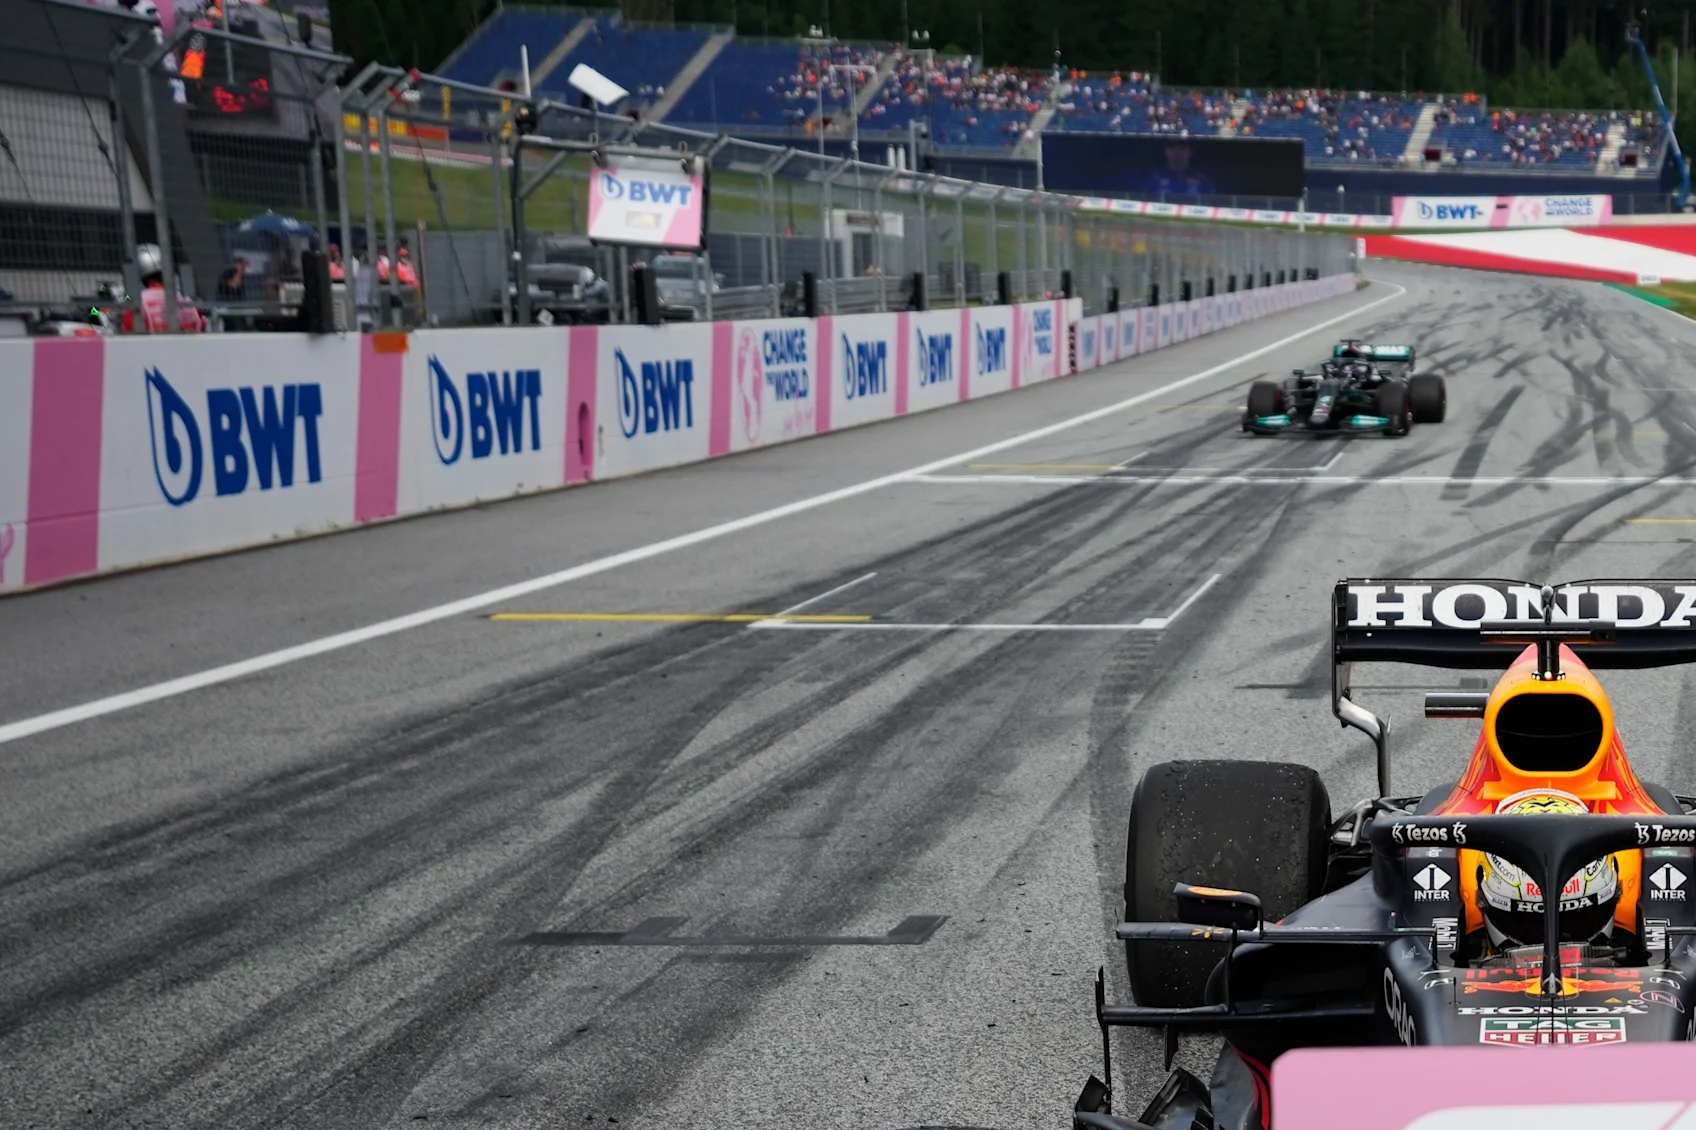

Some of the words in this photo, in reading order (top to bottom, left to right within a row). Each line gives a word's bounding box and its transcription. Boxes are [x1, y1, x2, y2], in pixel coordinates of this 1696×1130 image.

[629, 181, 692, 205] BWT
[1437, 204, 1475, 219] BWT
[763, 328, 808, 366] CHANGE
[929, 333, 953, 384] BWT
[857, 340, 887, 397] BWT
[641, 359, 693, 433] BWT
[774, 368, 809, 401] WORLD
[467, 369, 541, 458] BWT
[207, 383, 322, 496] BWT
[1406, 824, 1448, 841] Tezos
[1652, 825, 1695, 842] Tezos
[1414, 890, 1449, 899] INTER
[1526, 883, 1542, 896] Re
[1561, 879, 1580, 894] ull
[1650, 890, 1686, 899] INTER
[1384, 967, 1417, 1047] ORAC
[1457, 1006, 1649, 1015] HONDA
[1493, 1020, 1612, 1030] TAG
